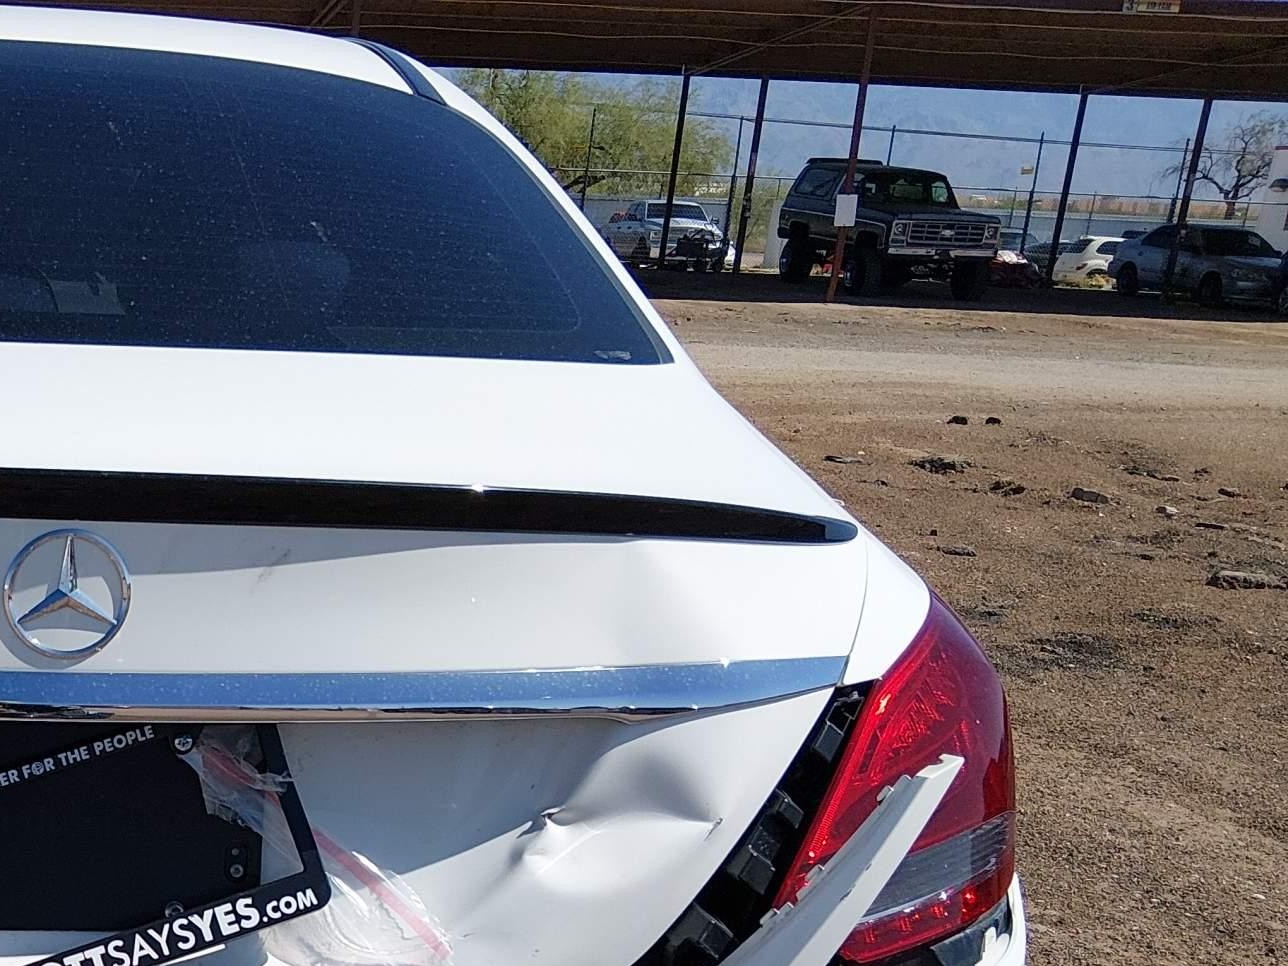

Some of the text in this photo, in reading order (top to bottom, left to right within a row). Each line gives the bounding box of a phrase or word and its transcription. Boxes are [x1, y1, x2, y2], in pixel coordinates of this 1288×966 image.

[22, 757, 55, 779] FOR
[58, 745, 90, 766] THE
[93, 725, 155, 755] PEOPLE
